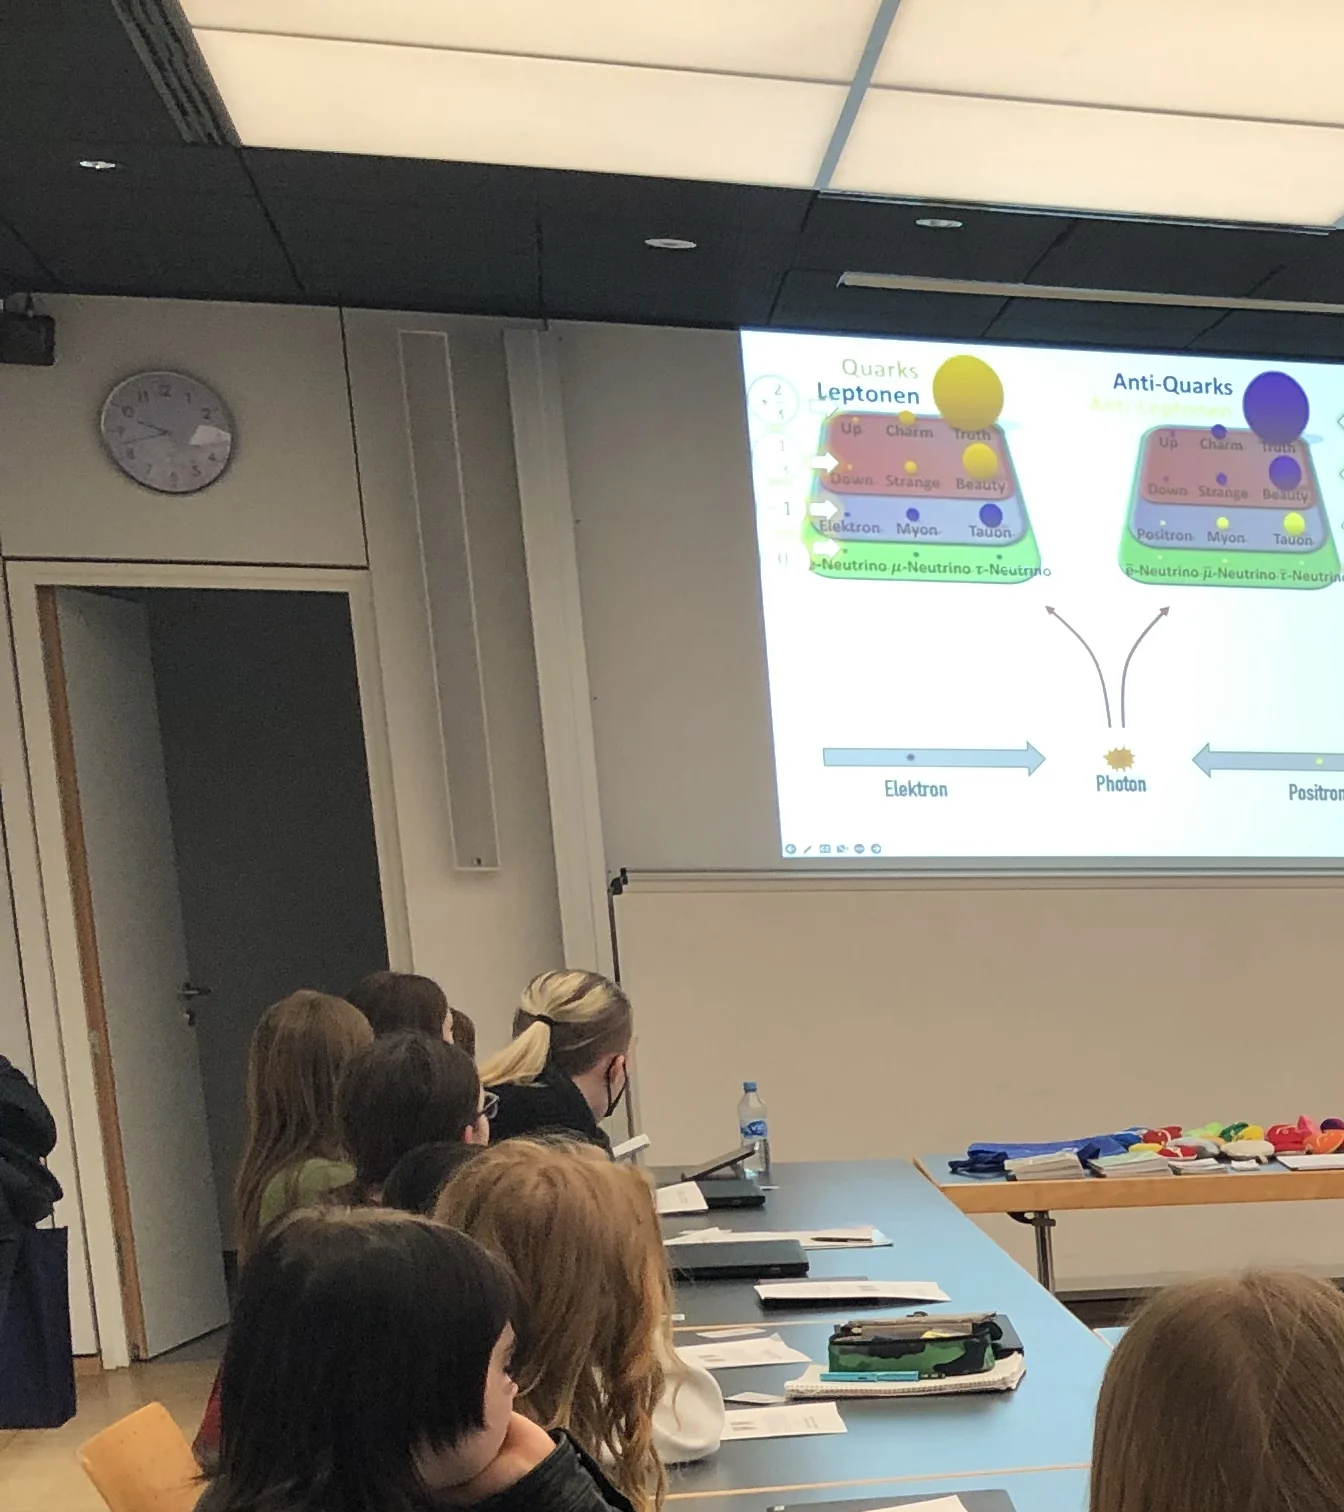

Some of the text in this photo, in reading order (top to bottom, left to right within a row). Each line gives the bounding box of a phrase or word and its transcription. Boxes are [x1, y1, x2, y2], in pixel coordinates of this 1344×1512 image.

[842, 358, 919, 379] Quarks
[817, 381, 920, 405] Leptonen
[1113, 373, 1234, 395] Anti-Quarks
[841, 422, 992, 441] Up Charm Truth
[1159, 436, 1179, 450] Up
[1199, 437, 1244, 452] Charm
[829, 471, 1006, 494] Down Strange Beauty
[1149, 482, 1309, 504] Down Strange Beauty
[819, 519, 1012, 539] Elektron Myon Tauon
[1136, 528, 1314, 547] Positron Myon Tauon
[884, 779, 949, 800] Elektron
[1096, 774, 1146, 793] Photon
